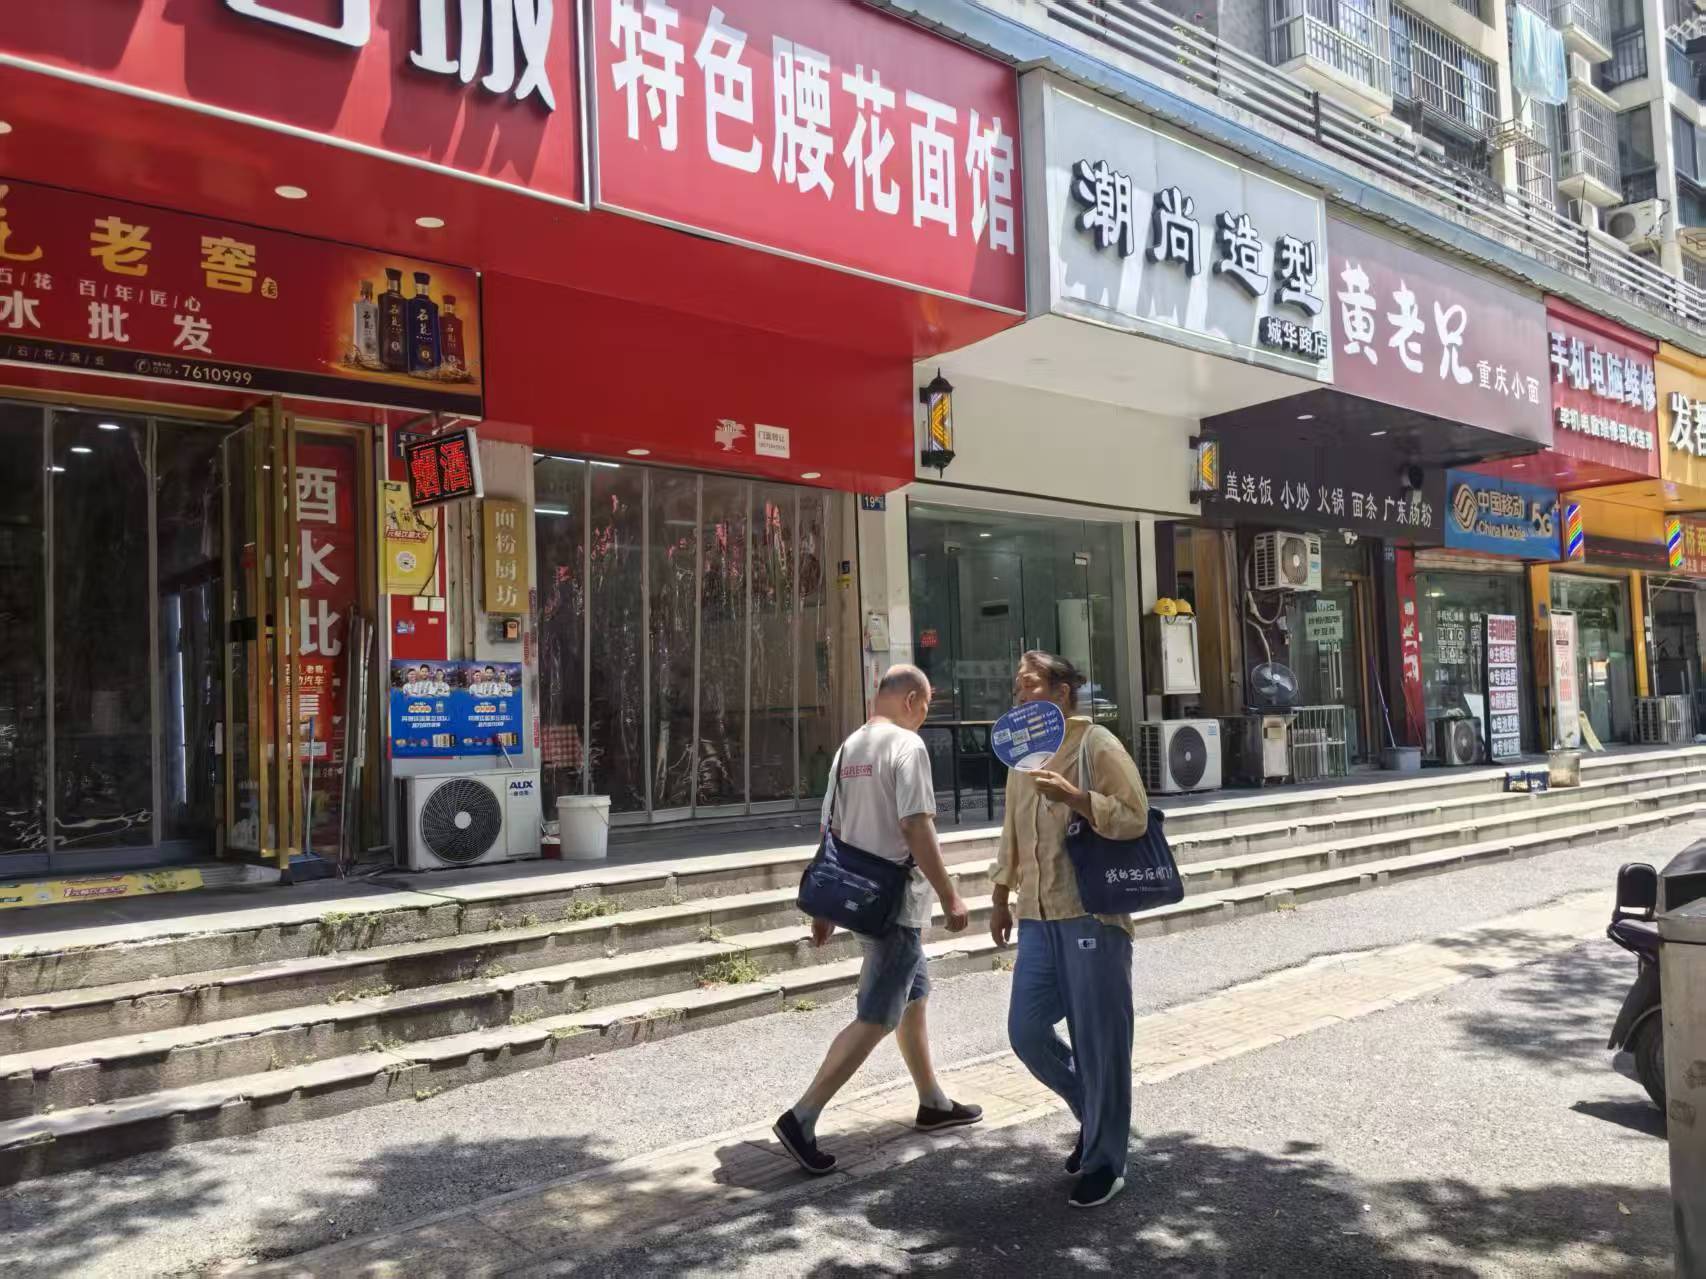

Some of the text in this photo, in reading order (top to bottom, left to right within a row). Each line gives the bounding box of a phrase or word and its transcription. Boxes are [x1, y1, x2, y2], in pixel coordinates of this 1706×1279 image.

[609, 0, 1016, 256] 特色腰花面馆
[1073, 159, 1324, 317] 潮尚造型
[0, 290, 213, 354] 水批发
[1265, 316, 1328, 357] 城华路店
[1336, 259, 1473, 385] 黄老兄
[182, 364, 252, 385] 7610999
[1476, 360, 1540, 404] 重庆小面
[1550, 331, 1657, 412] 手机电脑维修
[1225, 471, 1432, 529] 盖浇饭 小炒 火锅 面条 广东肠粉
[1477, 489, 1524, 519] 中国移动
[510, 780, 533, 789] AUX
